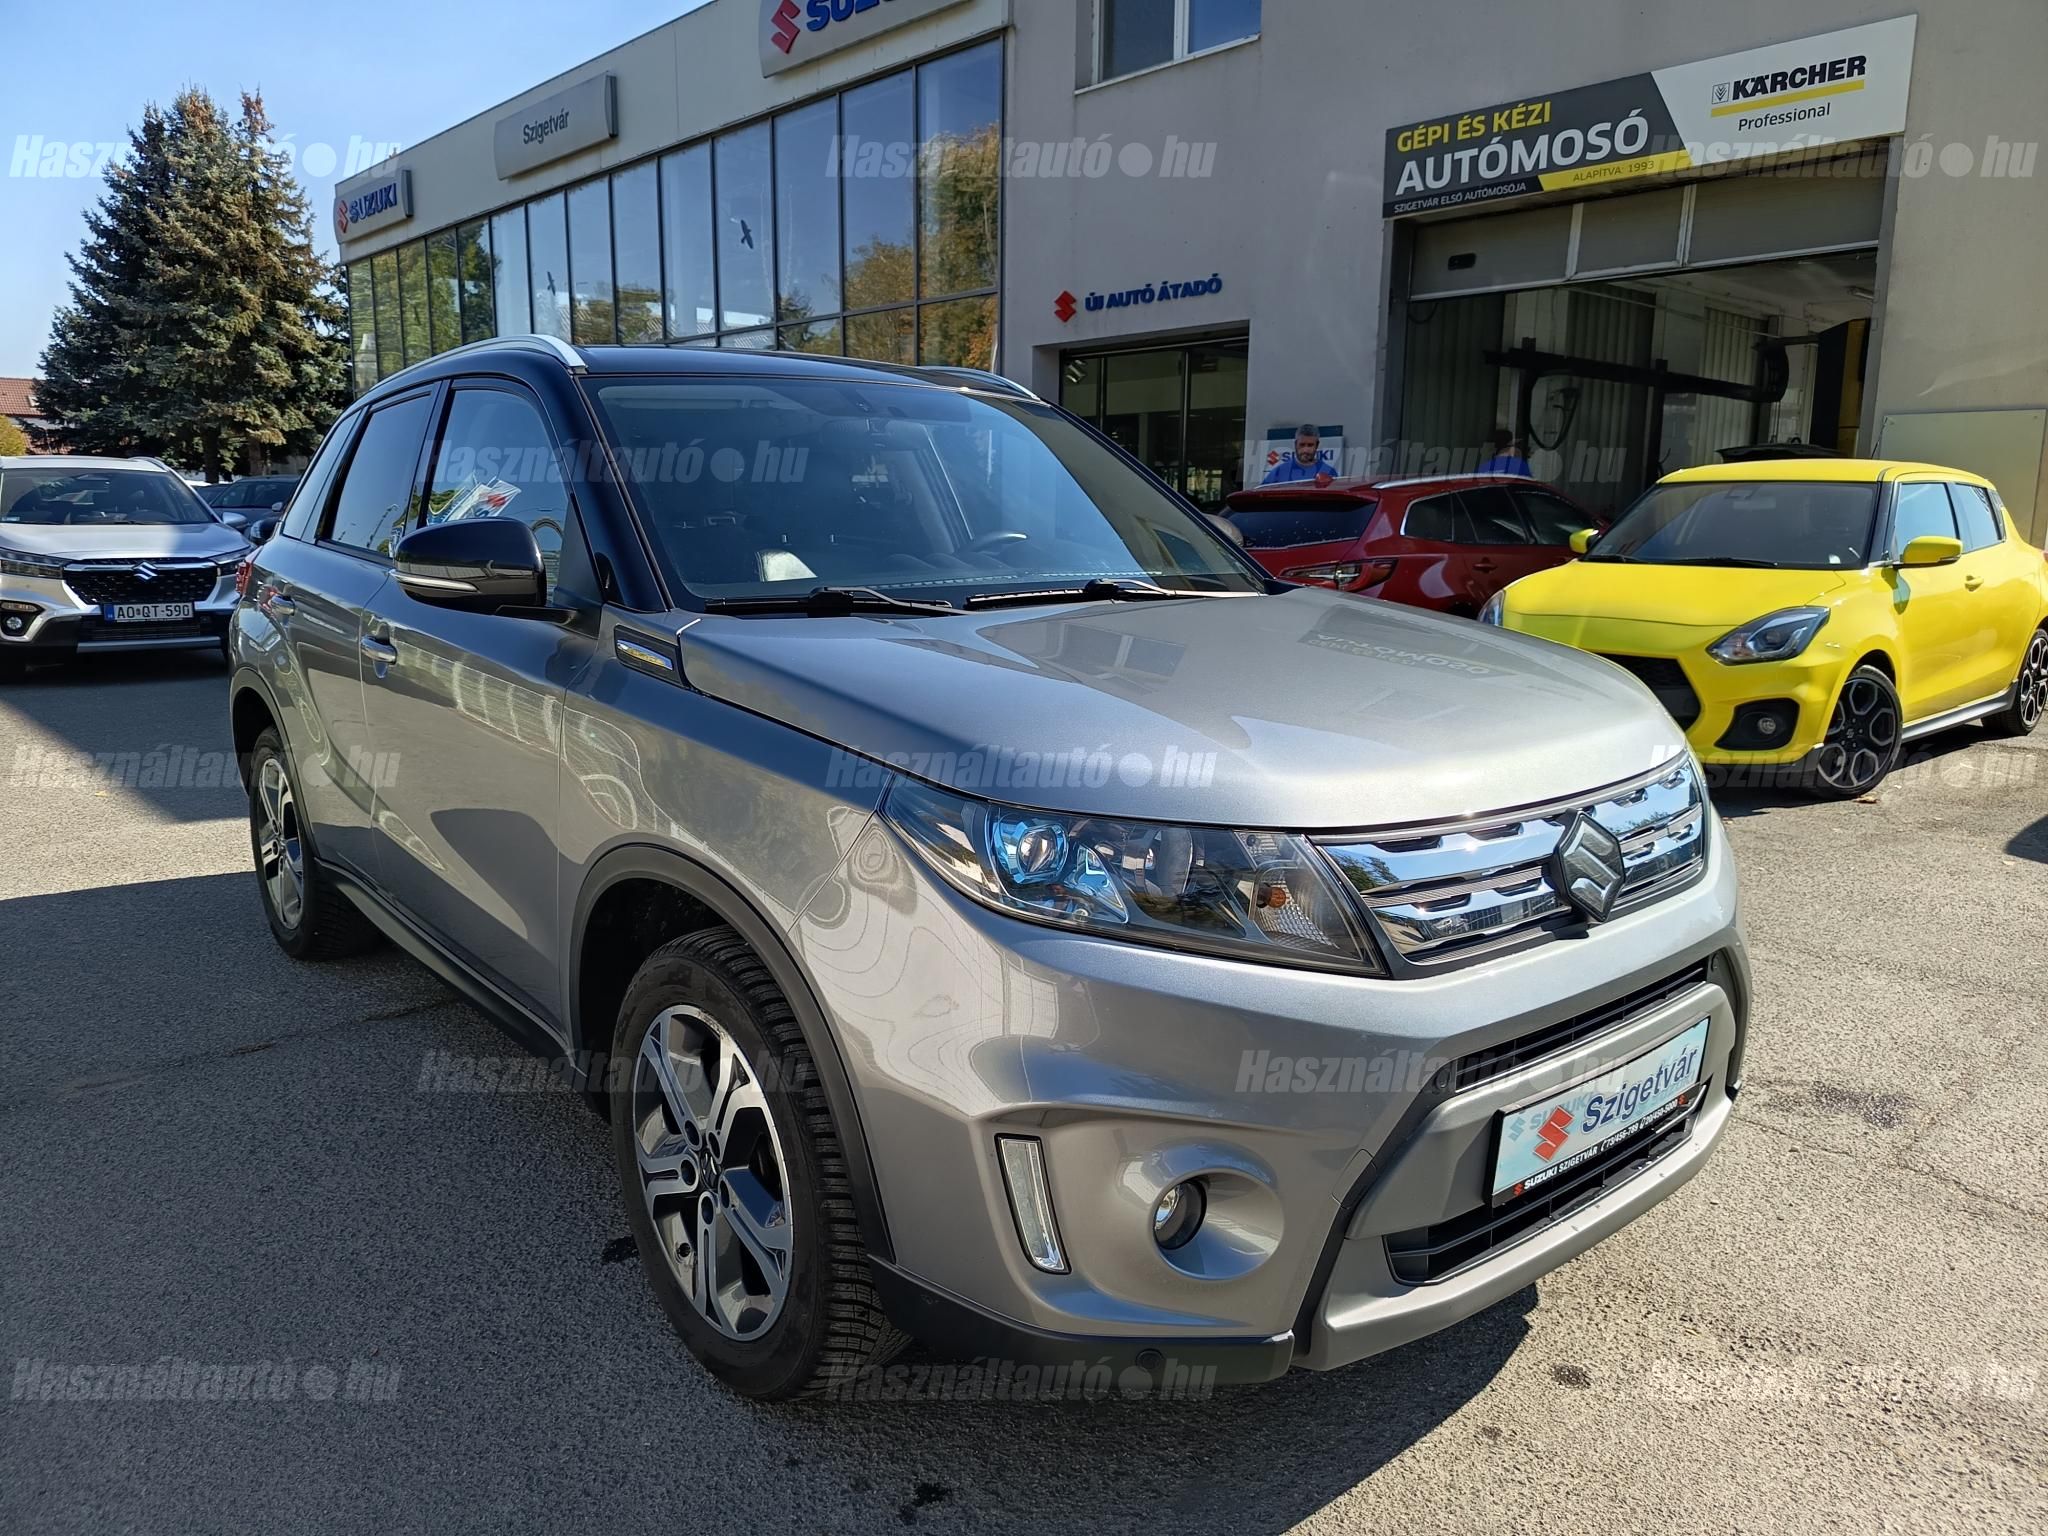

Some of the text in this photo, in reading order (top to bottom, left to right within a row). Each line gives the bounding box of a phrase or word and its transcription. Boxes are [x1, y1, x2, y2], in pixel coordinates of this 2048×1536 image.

[1732, 55, 1867, 101] KÄRCHER
[523, 109, 570, 144] Szigetvár
[1396, 100, 1552, 153] GÉPI ÉS KÉZI
[1738, 102, 1831, 131] Professional
[1395, 107, 1650, 196] AUTÓMOSÓ
[1627, 159, 1655, 174] 1993
[350, 182, 398, 223] SUZUKI
[1106, 283, 1156, 309] AUTÓ
[1157, 272, 1223, 302] ÁTADÓ
[1582, 1047, 1698, 1133] Szigetvár
[1524, 1166, 1558, 1190] SUZUKI
[1559, 1146, 1598, 1173] SZIGETVÁR
